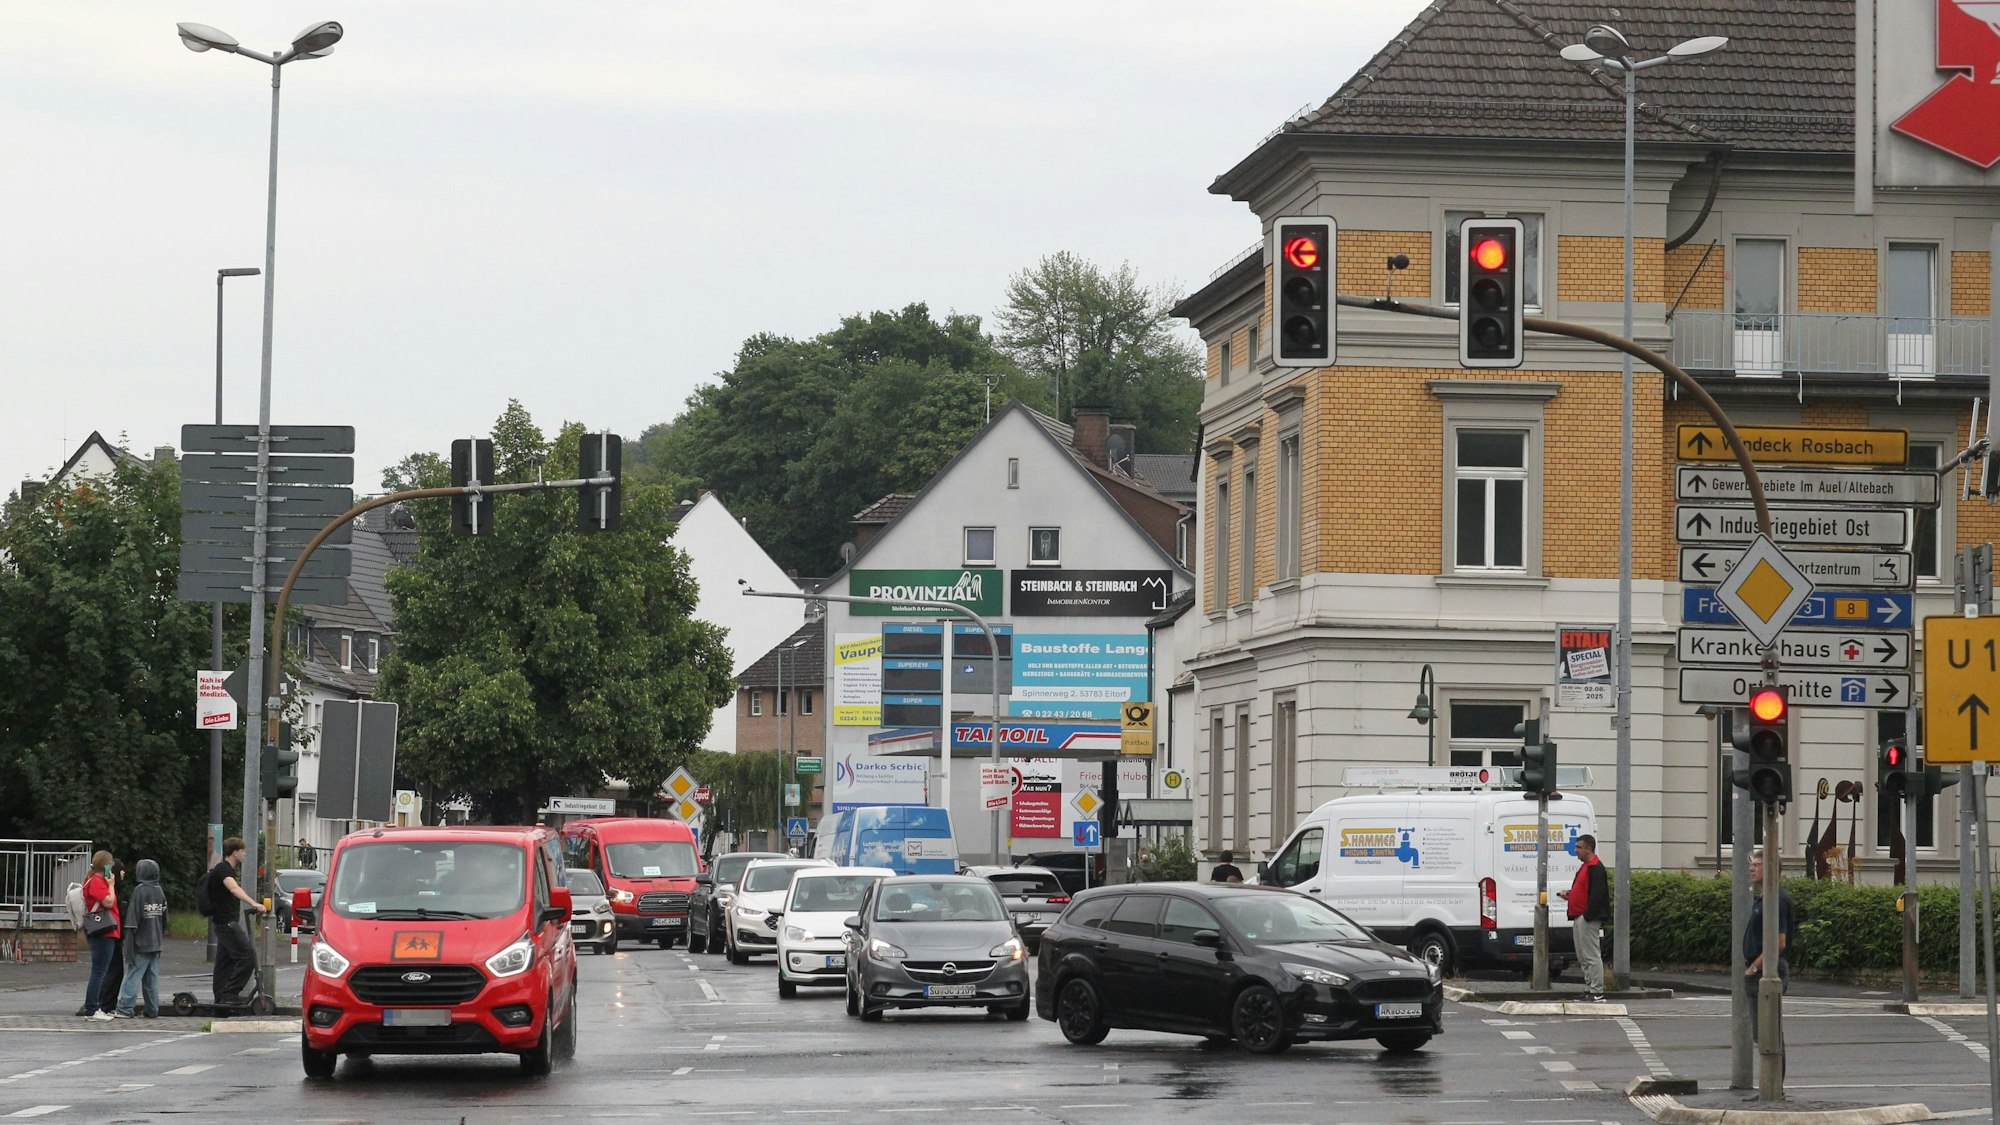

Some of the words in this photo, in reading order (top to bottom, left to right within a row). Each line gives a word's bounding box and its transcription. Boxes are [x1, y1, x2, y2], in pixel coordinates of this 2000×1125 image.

[1721, 436, 1792, 453] Wndeck
[1802, 438, 1874, 454] Rosbach
[1712, 478, 1796, 492] Gewerbebiete
[1800, 480, 1813, 493] Im
[1720, 516, 1837, 540] Indusriegebiet
[1846, 519, 1870, 536] Ost
[870, 586, 977, 601] PROVINZIAL
[1020, 580, 1072, 592] STEINBACH
[1075, 580, 1083, 592] &
[1086, 580, 1138, 592] STEINBACH
[1847, 603, 1856, 615] 8
[840, 645, 882, 660] Vaupe
[1021, 643, 1100, 654] Baustoffe
[1692, 637, 1831, 657] Krankehaus
[1571, 650, 1601, 662] SPECIAL
[1948, 639, 1970, 670] U
[1983, 639, 1996, 672] 1
[1022, 689, 1069, 699] Spinnerweg
[1070, 690, 1078, 698] 2,
[1080, 690, 1103, 698] 53783
[1105, 690, 1127, 698] Eitorf
[1733, 678, 1832, 699] Omitte
[955, 727, 1050, 744] TAMOIL
[1450, 770, 1478, 778] BRÖTJE
[564, 802, 598, 810] Industriegebiet
[1340, 828, 1396, 847] S.HAMMER
[1511, 844, 1537, 852] HEIZUNG
[1503, 864, 1529, 873] WÄRME
